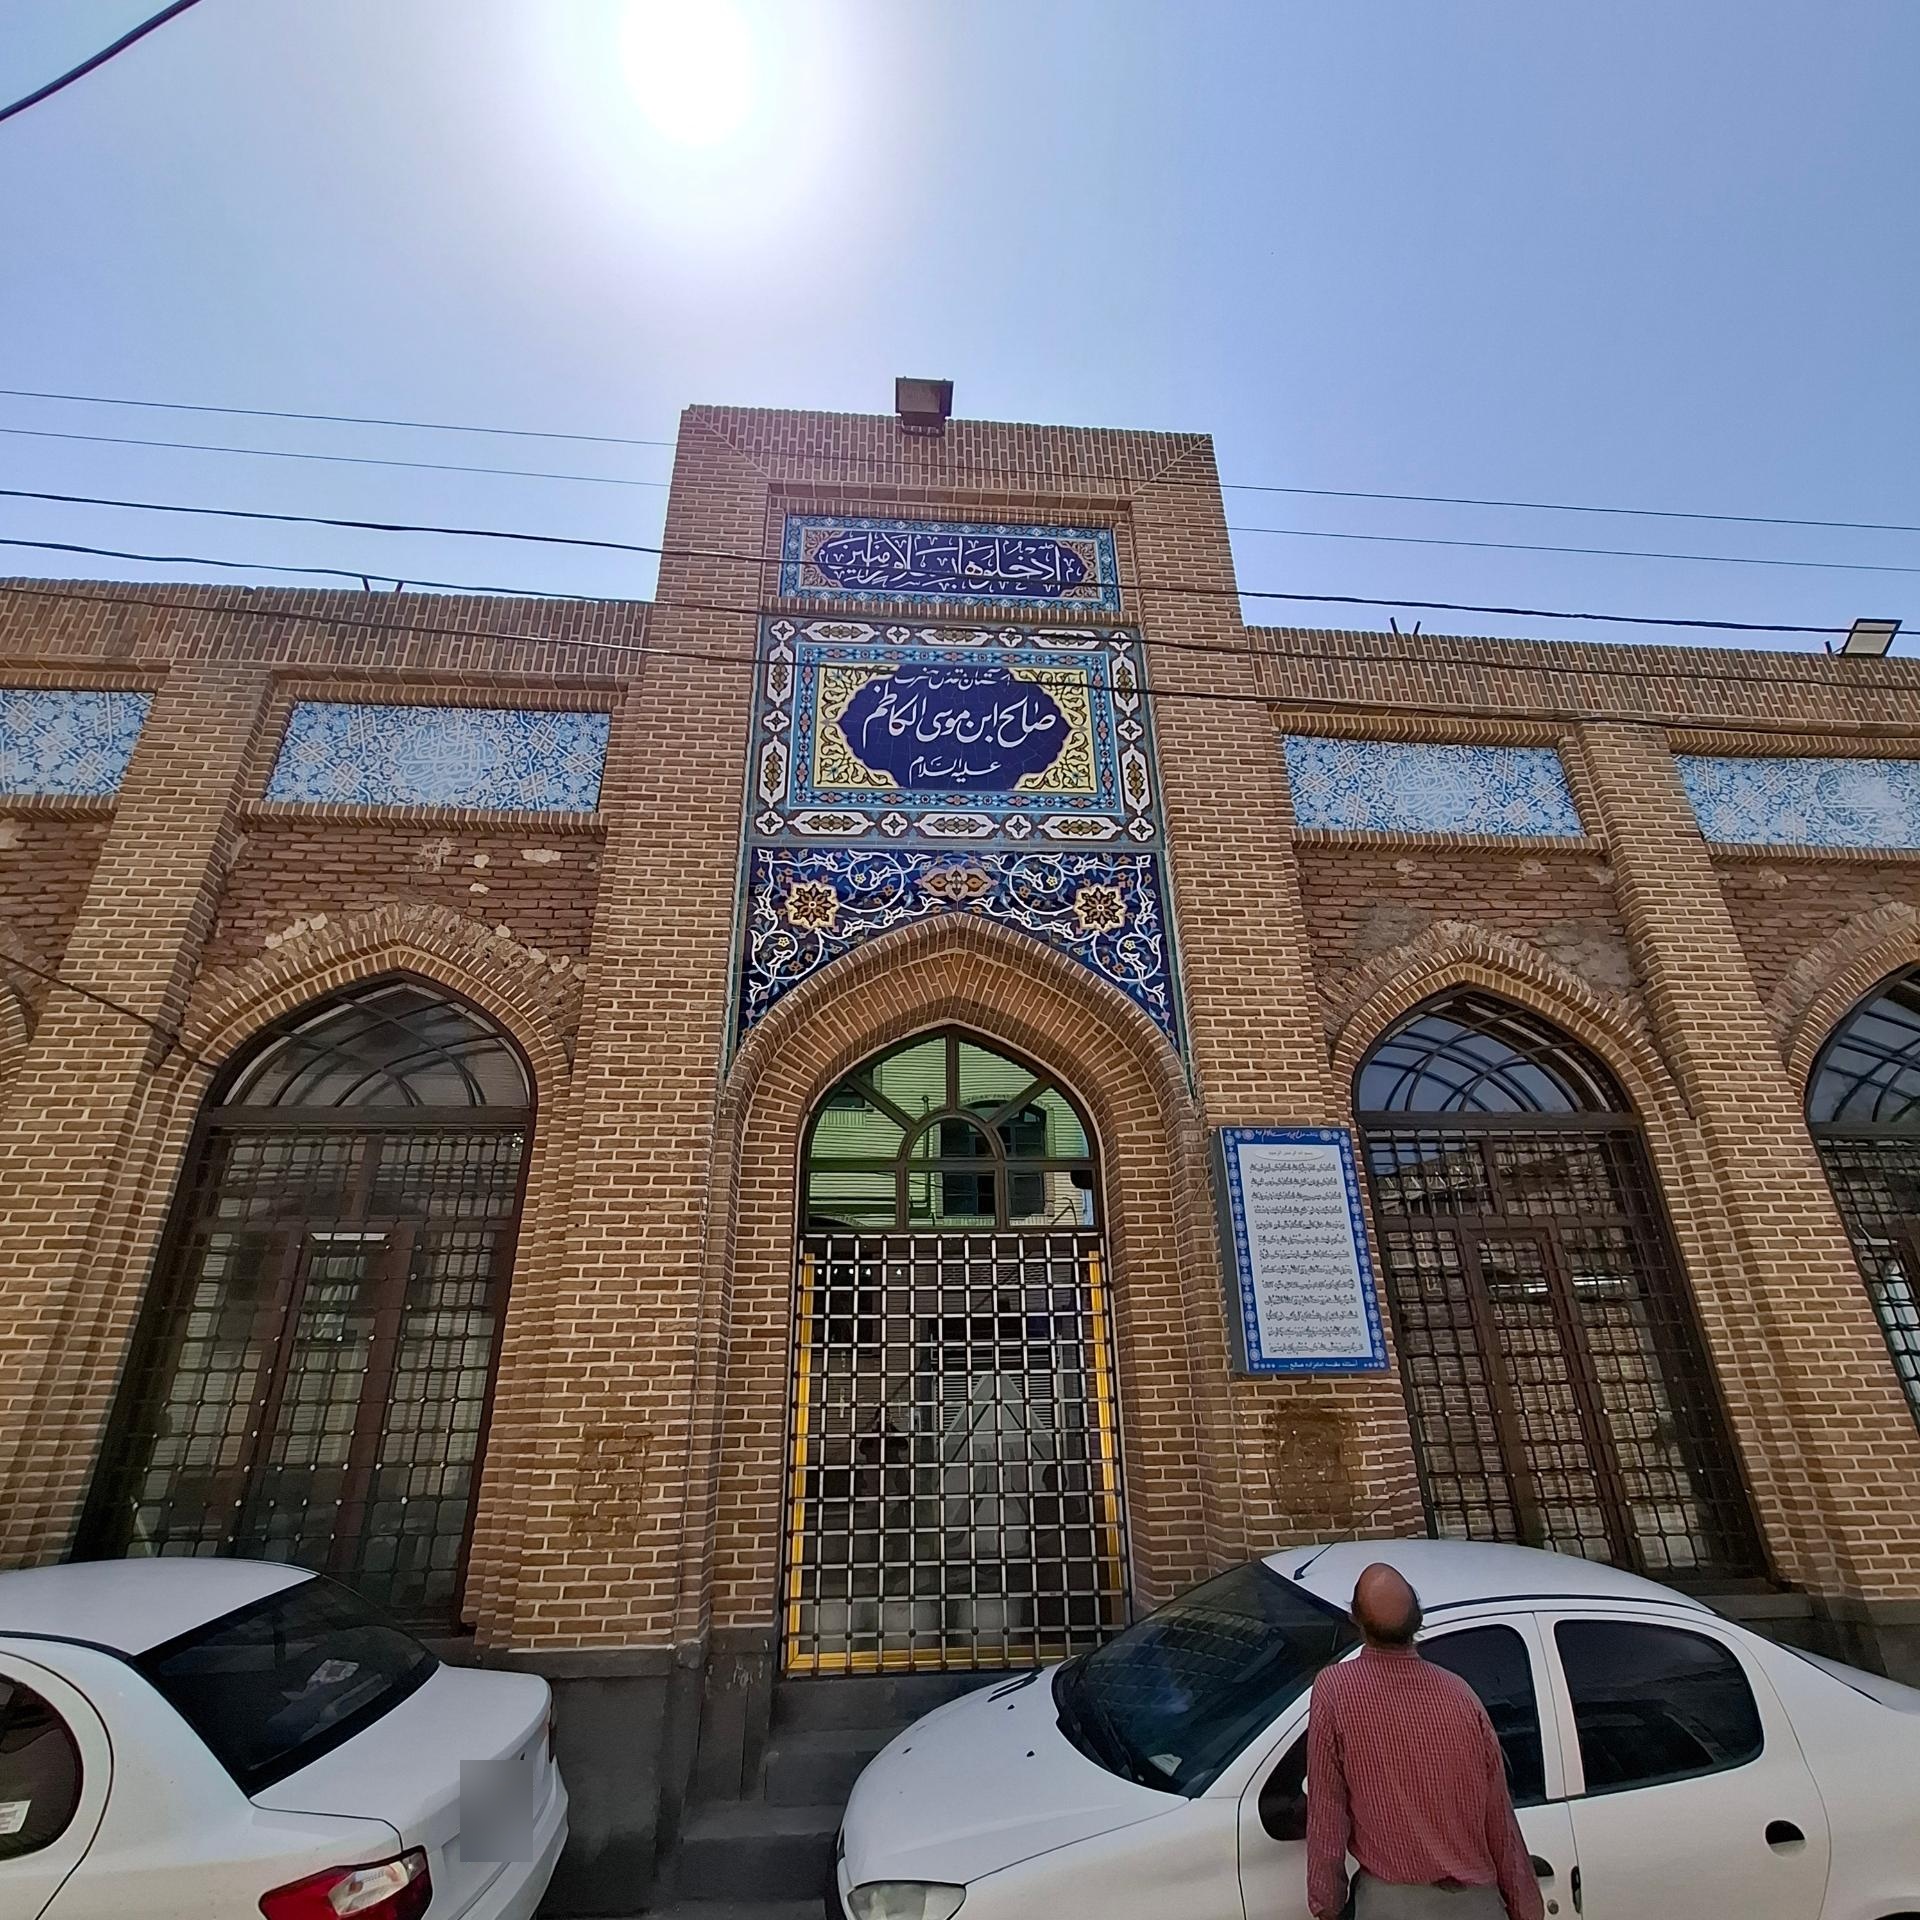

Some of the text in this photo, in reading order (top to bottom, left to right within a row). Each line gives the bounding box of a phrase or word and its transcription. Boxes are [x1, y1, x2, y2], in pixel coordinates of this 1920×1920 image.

[862, 681, 928, 750] الکاظم
[955, 701, 999, 744] ابن
[997, 695, 1057, 748] صالح
[951, 760, 1002, 785] علیه
